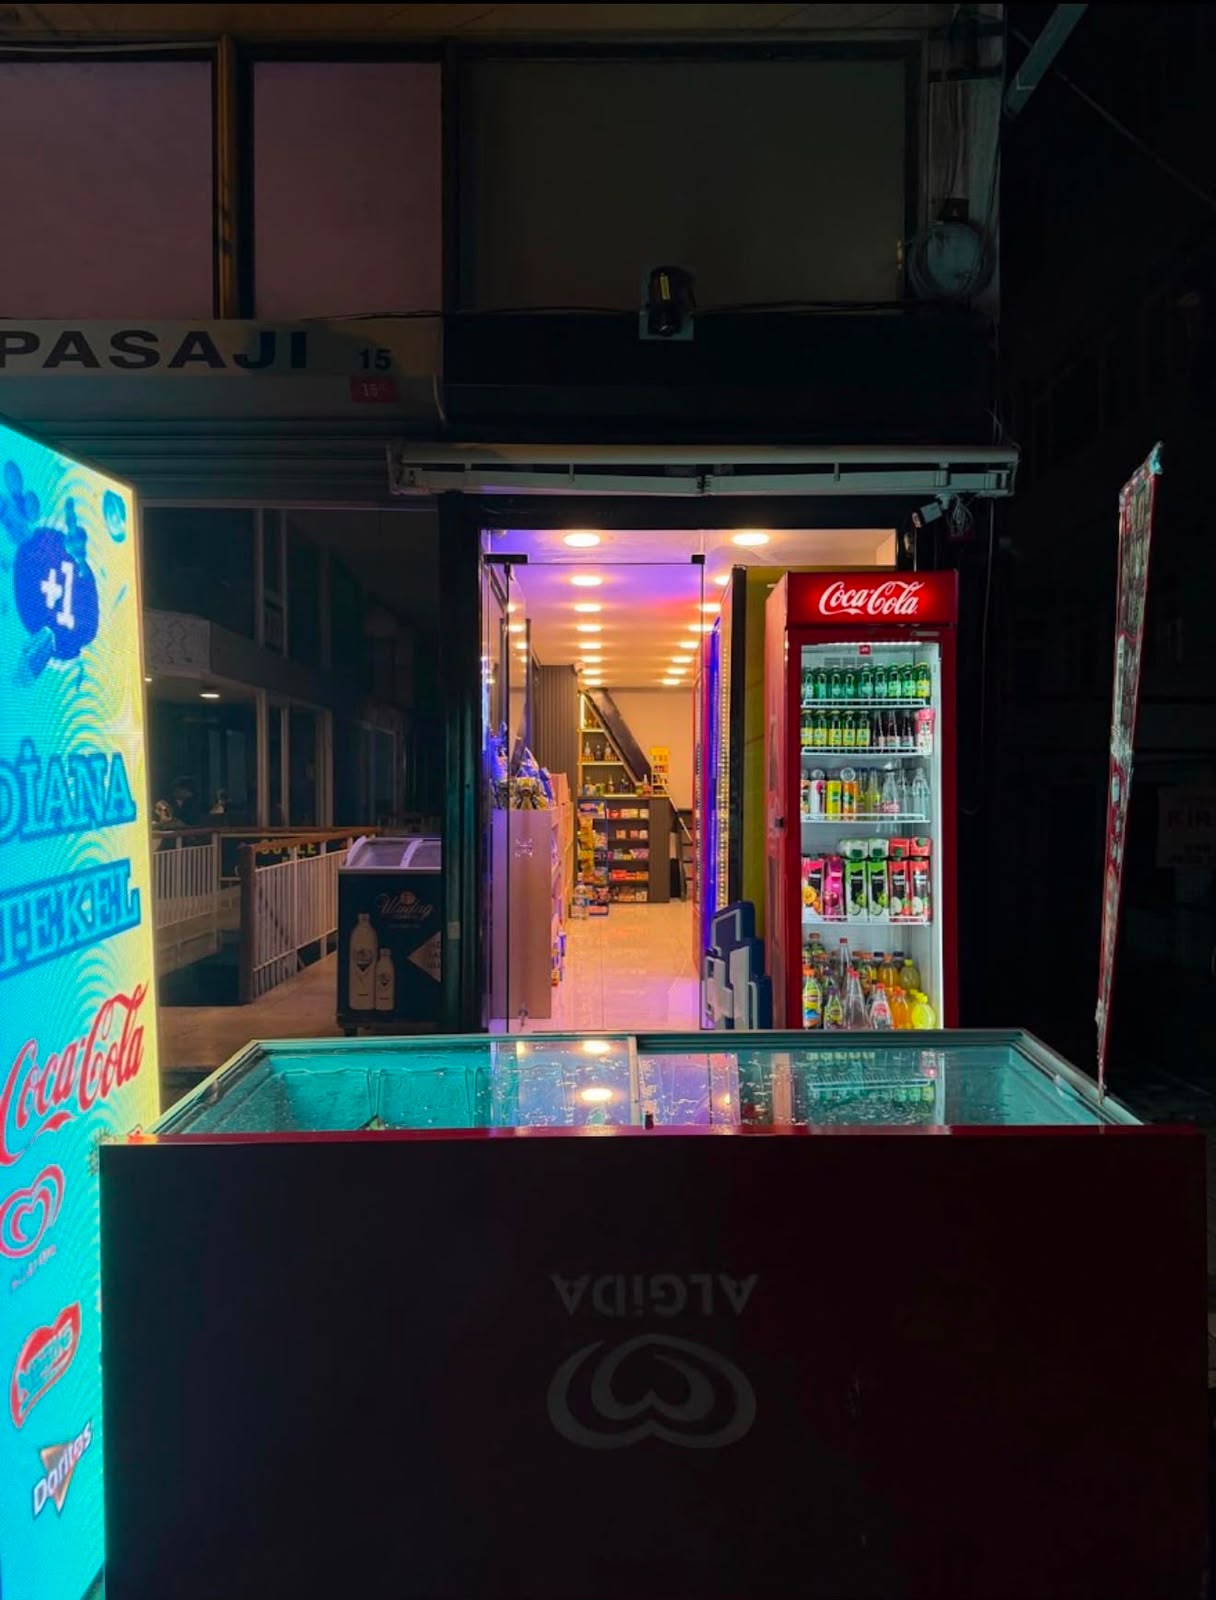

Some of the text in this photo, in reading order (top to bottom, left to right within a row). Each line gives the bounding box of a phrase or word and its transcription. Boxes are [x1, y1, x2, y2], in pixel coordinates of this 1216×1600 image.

[0, 331, 307, 369] PASAJI
[359, 348, 392, 370] 15
[818, 580, 925, 616] Coca-Cola
[0, 979, 149, 1166] Coca-Cola
[33, 1419, 93, 1517] Doritos
